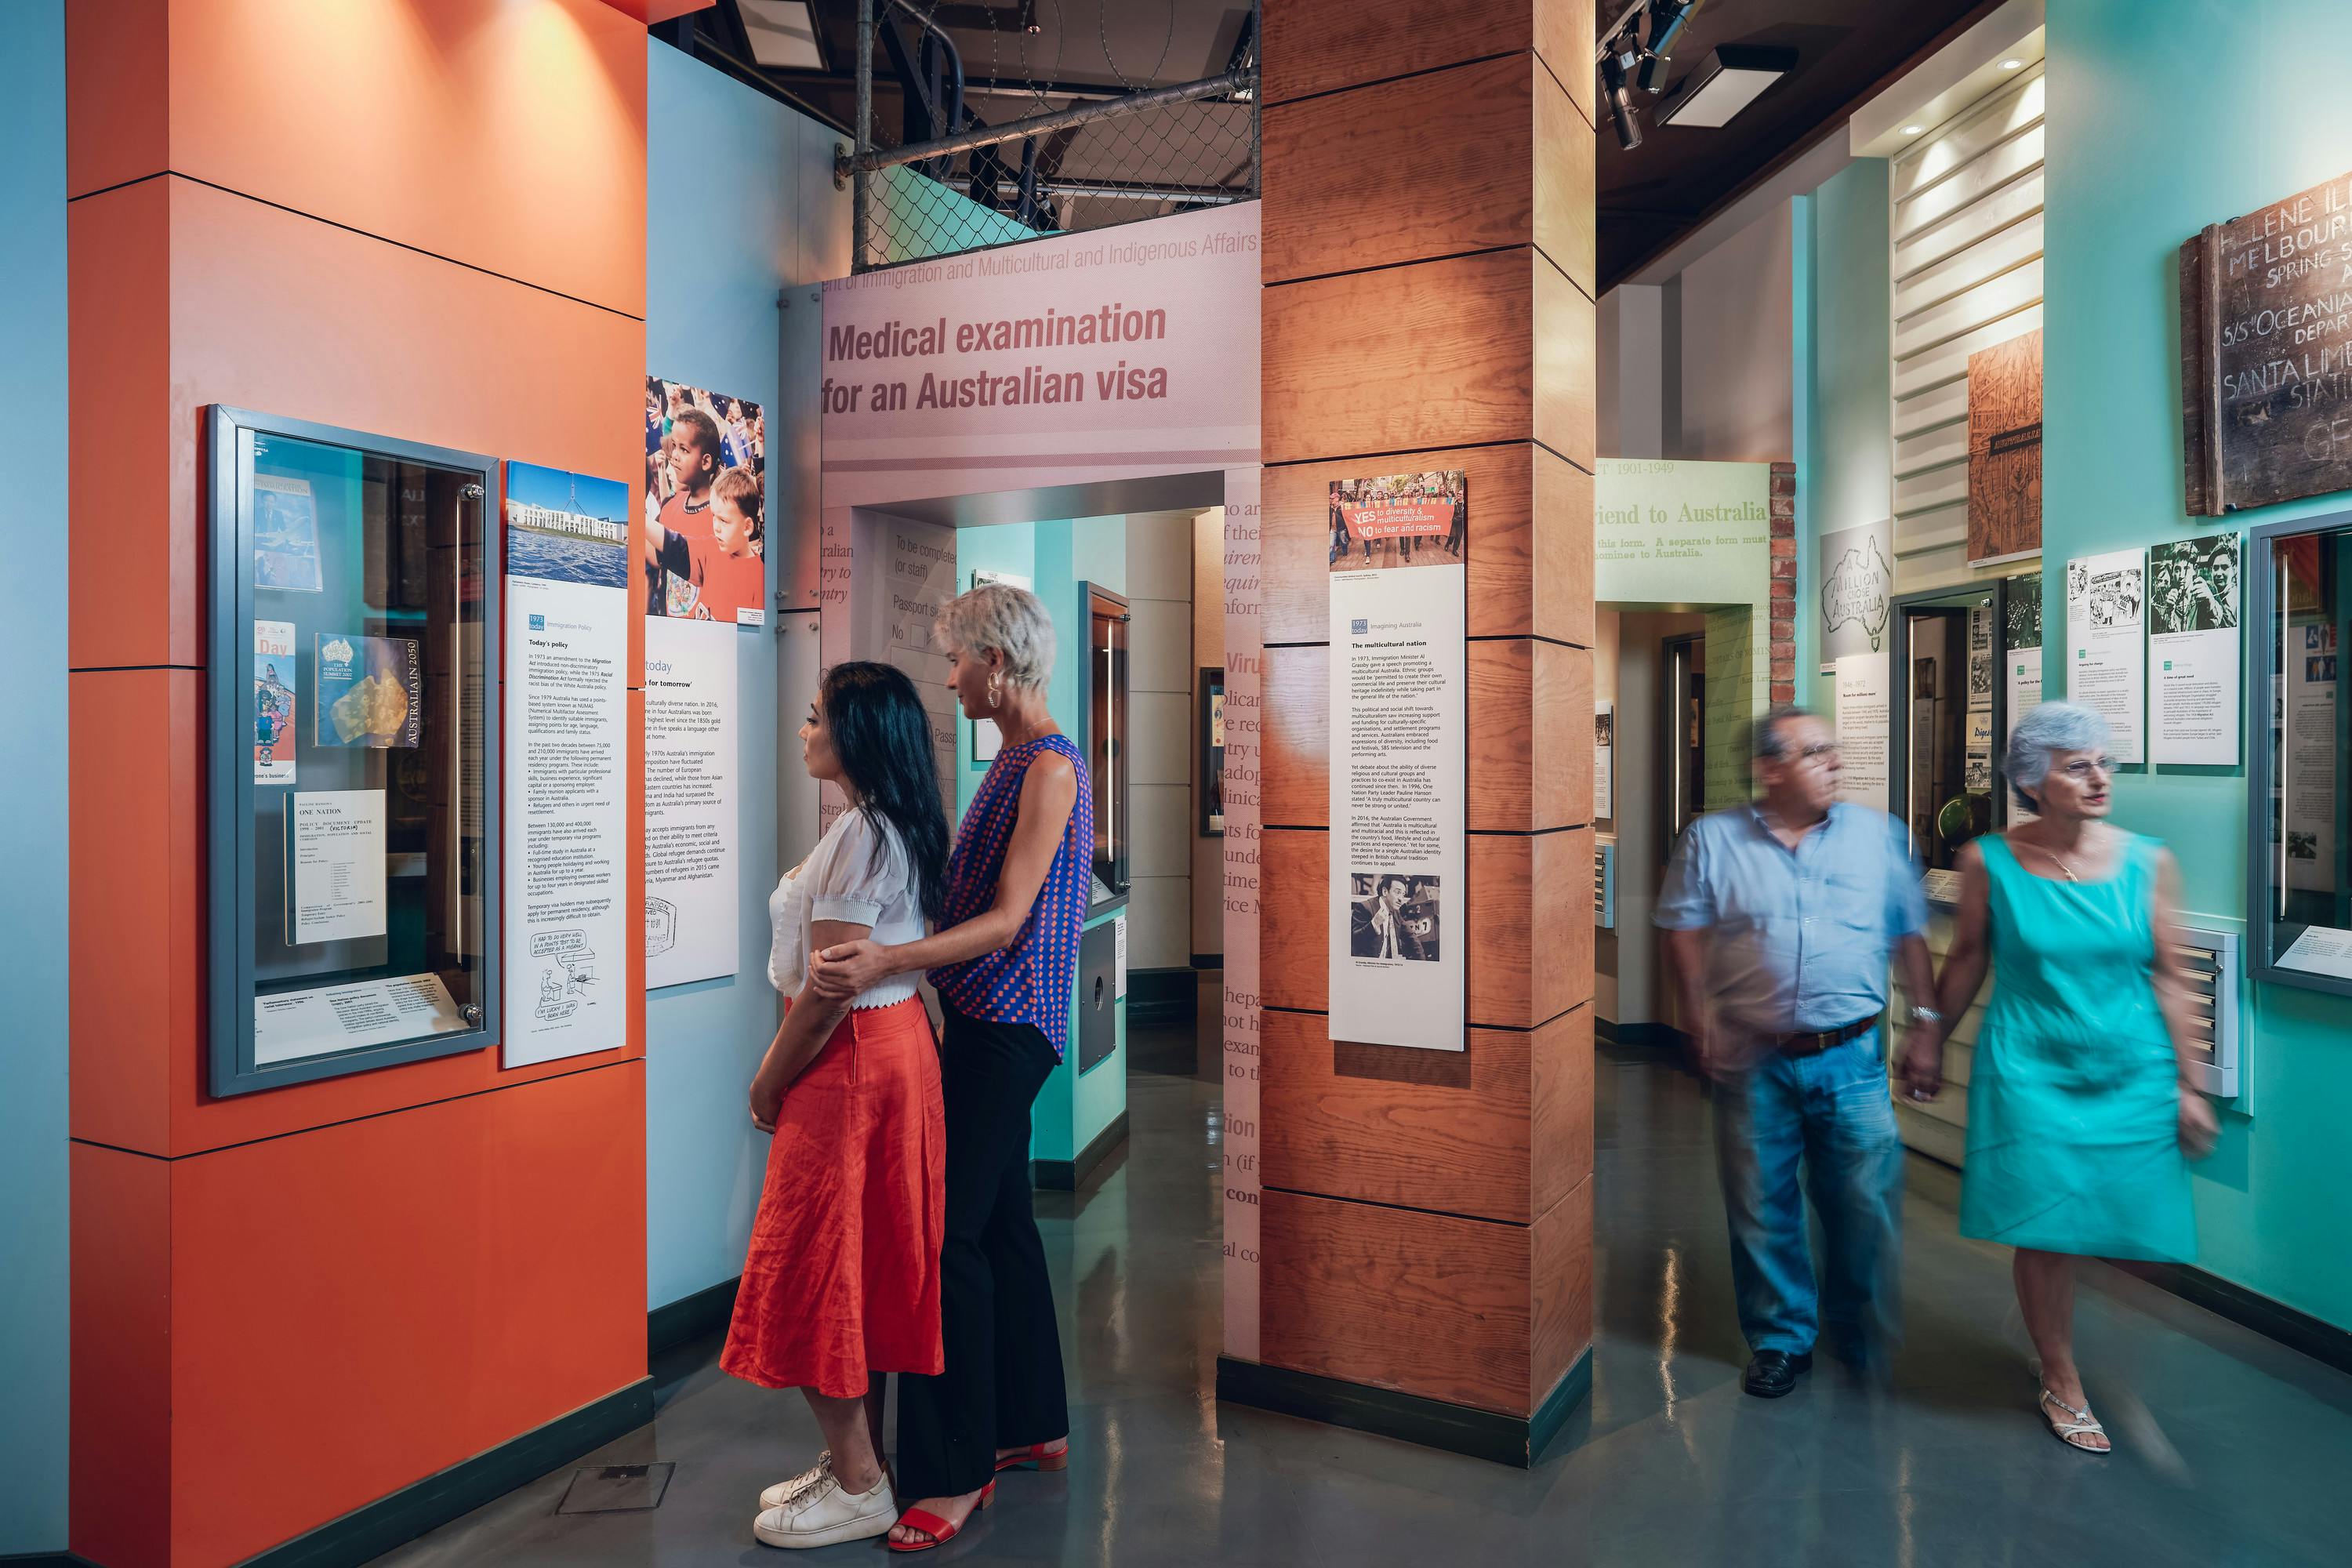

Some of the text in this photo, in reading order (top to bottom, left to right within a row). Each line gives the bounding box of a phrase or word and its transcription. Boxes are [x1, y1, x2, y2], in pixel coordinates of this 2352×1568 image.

[2230, 212, 2352, 276] MELBOUR
[863, 263, 942, 289] Immigration
[947, 260, 973, 280] and
[979, 249, 1069, 276] Multicultural
[1074, 248, 1103, 268] and
[1109, 238, 1196, 266] Indigenous
[1202, 231, 1258, 256] Affairs
[2266, 240, 2352, 289] SPRING S
[829, 302, 1166, 361] Medical examination
[2295, 312, 2352, 345] DEPAR
[822, 361, 1167, 414] for an Australian visa
[2223, 359, 2300, 400] SANTA
[2290, 372, 2352, 409] STATI
[1617, 462, 1674, 475] 1901-1949
[1354, 511, 1376, 524] YES
[1377, 514, 1435, 524] multiculturalism
[1595, 501, 1767, 524] iend to Australia
[1358, 526, 1373, 537] NO
[1402, 524, 1414, 532] and
[897, 535, 906, 550] To
[908, 539, 917, 554] be
[1599, 539, 1616, 548] this
[1621, 538, 1645, 547] form.
[1656, 537, 1664, 547] A
[1668, 536, 1711, 547] separate
[1715, 535, 1737, 544] form
[1655, 548, 1703, 558] Australia.
[840, 567, 851, 579] to
[895, 557, 927, 582] (or staff)
[1846, 558, 1853, 572] A
[1831, 571, 1879, 598] MILLION
[1847, 587, 1869, 600] CHOSE
[893, 594, 928, 616] Passport
[1833, 593, 1884, 621] AUSTRALIA
[547, 621, 577, 630] Immigration
[892, 624, 903, 640] No
[260, 639, 287, 658] Day
[408, 642, 417, 665] 2050
[645, 660, 672, 674] today
[408, 667, 418, 744] AUSTRALIA IN
[1229, 1064, 1245, 1077] to
